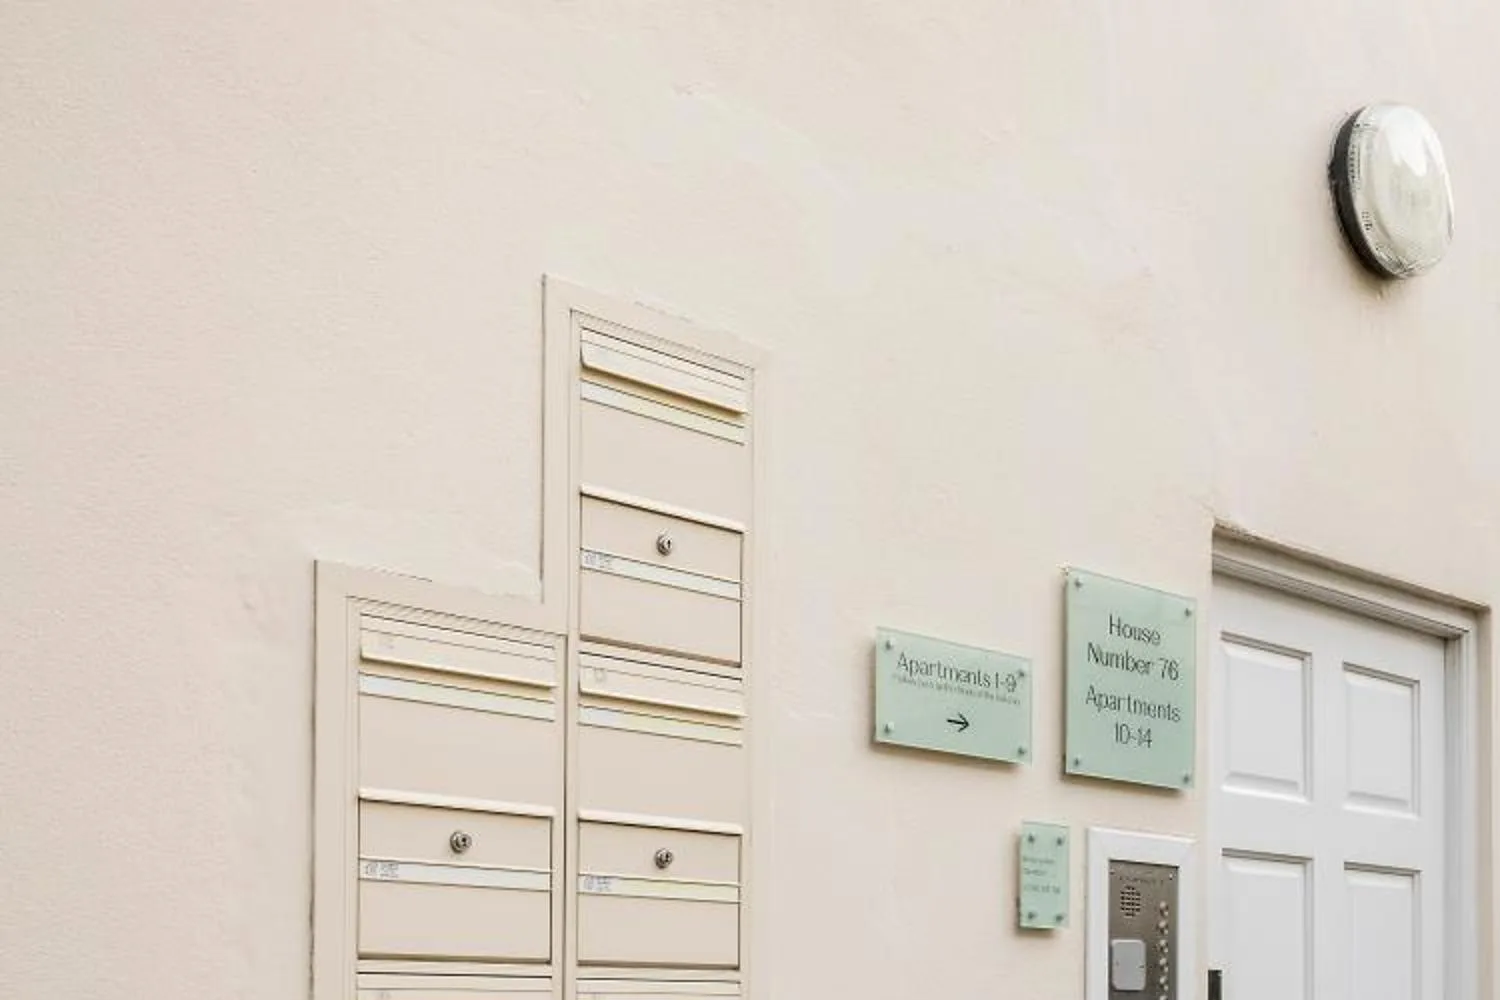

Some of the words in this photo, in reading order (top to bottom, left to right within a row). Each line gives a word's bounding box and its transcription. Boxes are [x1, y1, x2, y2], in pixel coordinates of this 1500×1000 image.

[1108, 613, 1161, 647] House
[897, 651, 992, 690] Apartments
[995, 671, 1018, 693] 1-9
[1087, 642, 1153, 675] Number
[1159, 657, 1180, 681] 76
[1085, 684, 1181, 723] Apartments
[1115, 721, 1153, 748] 10-14
